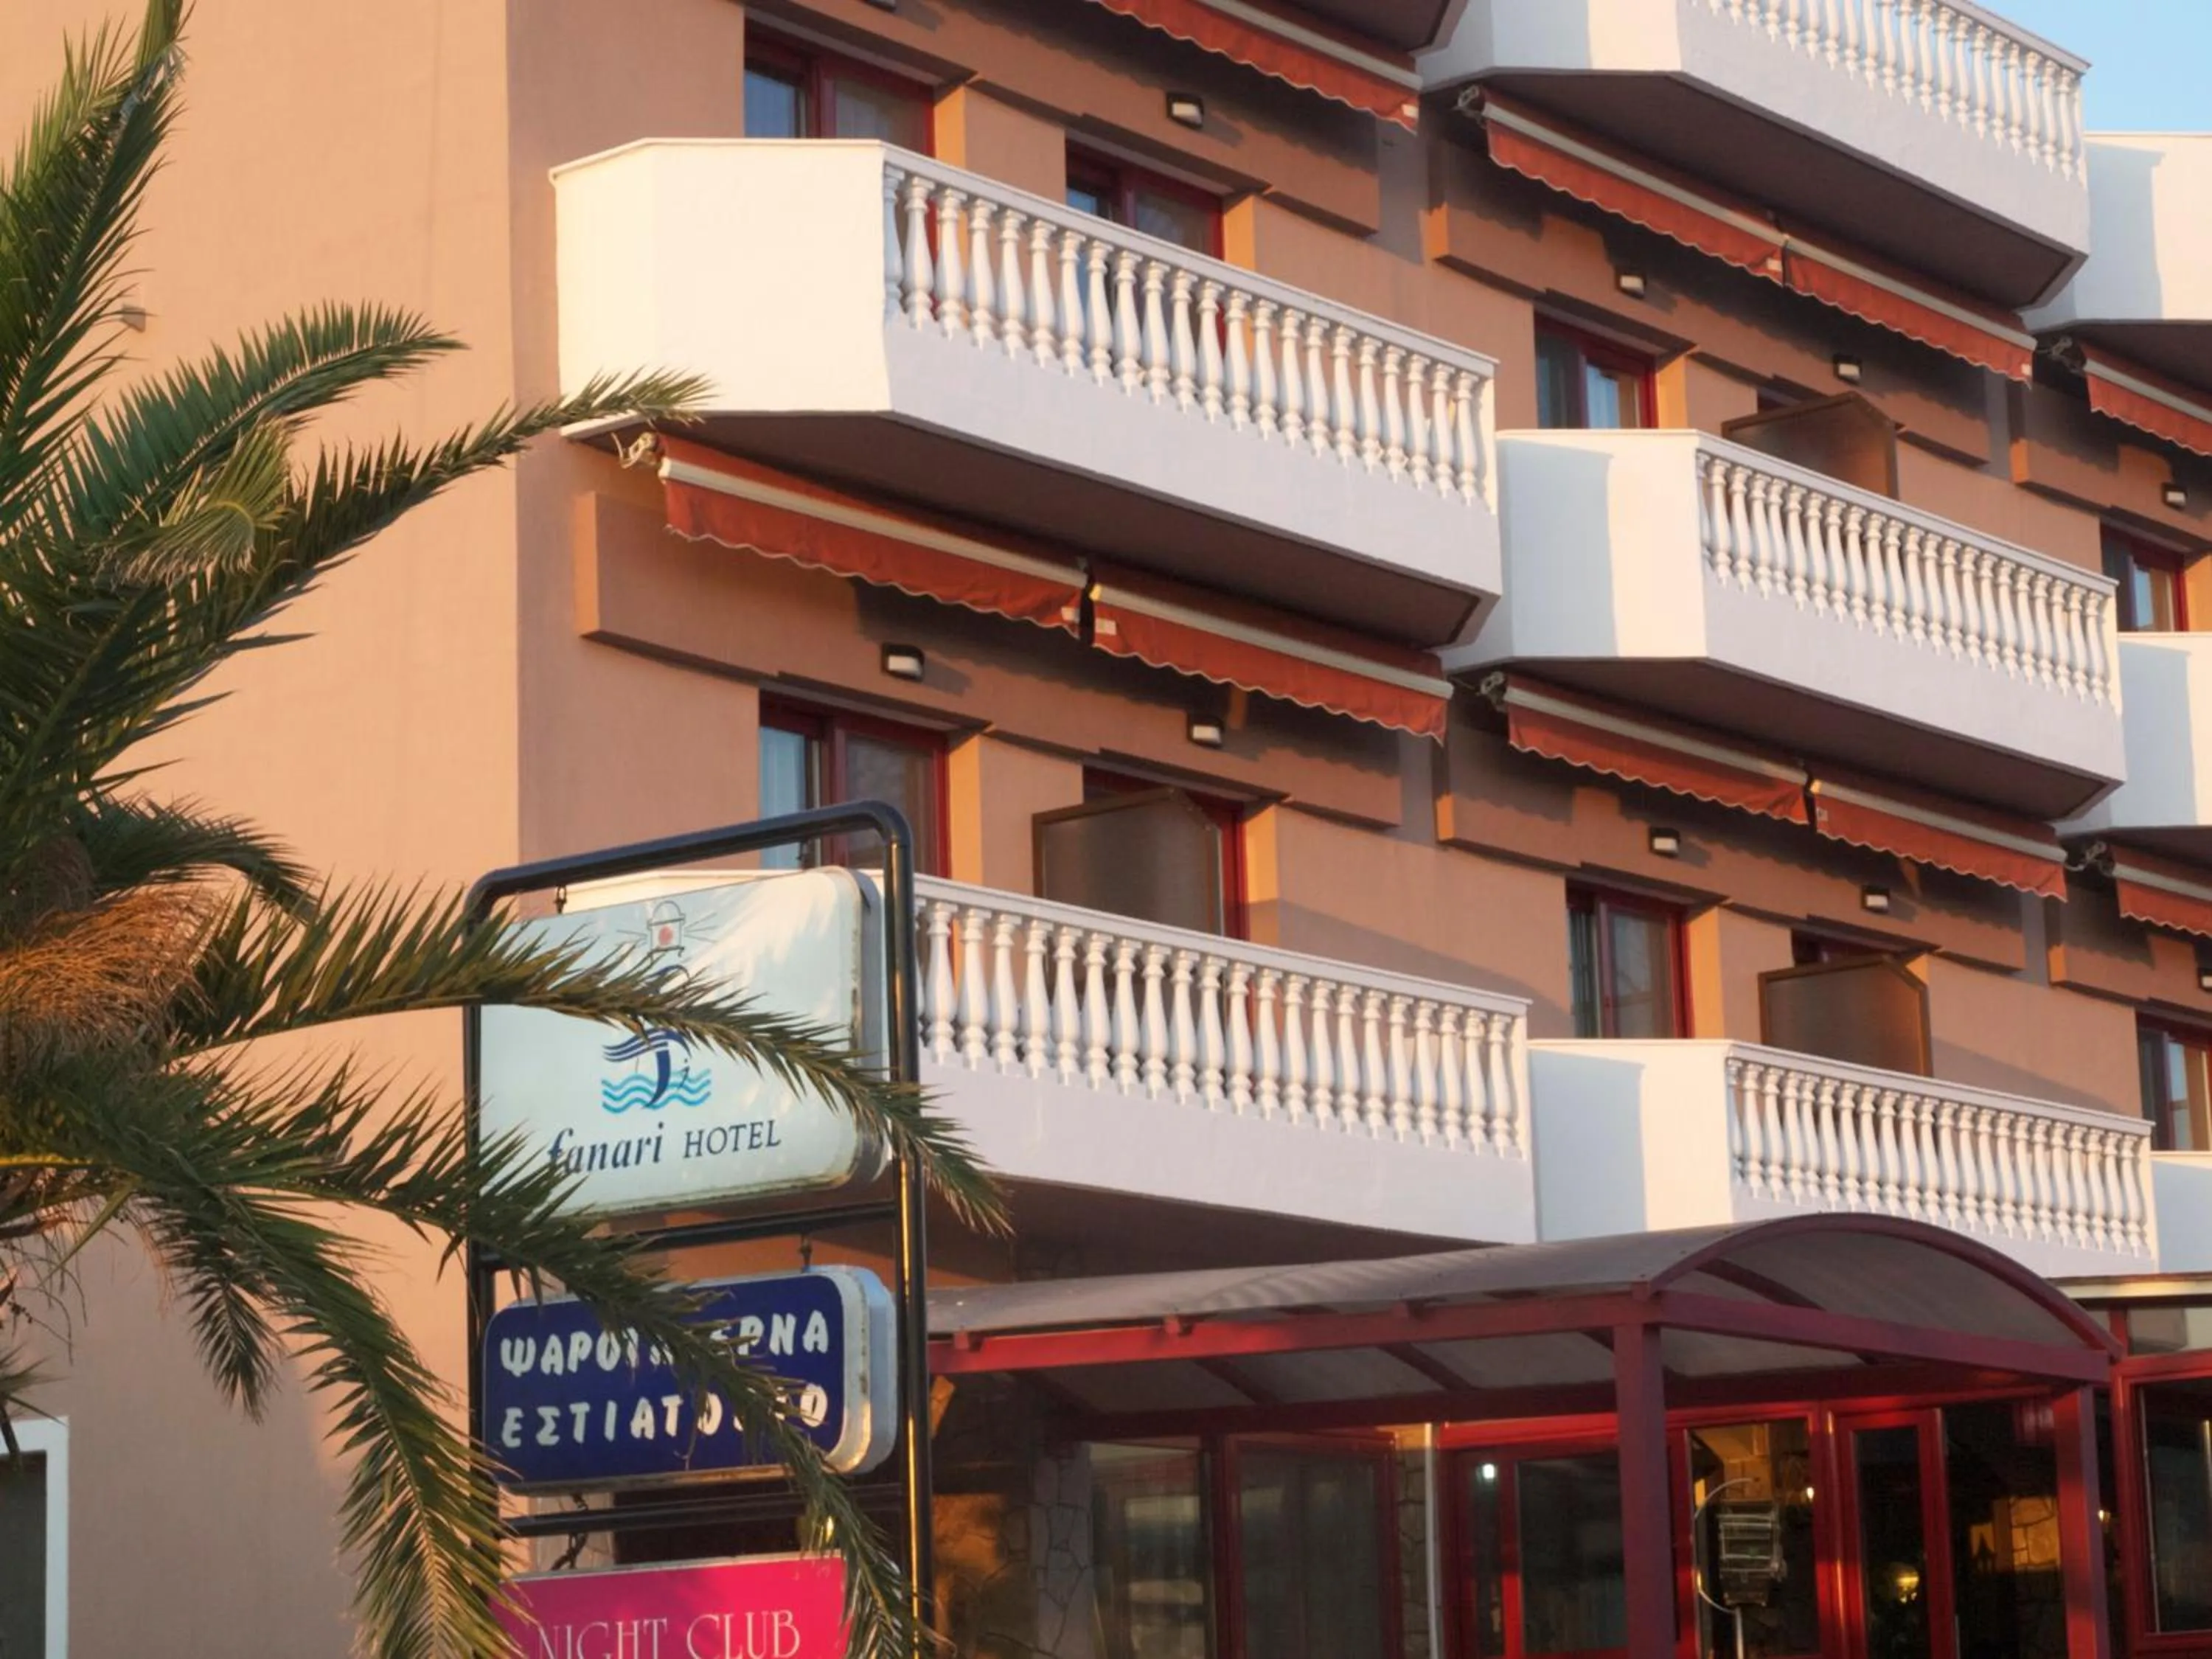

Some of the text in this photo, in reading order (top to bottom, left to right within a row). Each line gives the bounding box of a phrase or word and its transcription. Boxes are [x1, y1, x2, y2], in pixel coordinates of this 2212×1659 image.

[547, 1119, 782, 1174] fanari HOTEL
[501, 1382, 828, 1448] ΕΣΤΙΑΤΟΟ
[538, 1610, 801, 1659] NIGHT CLUB
